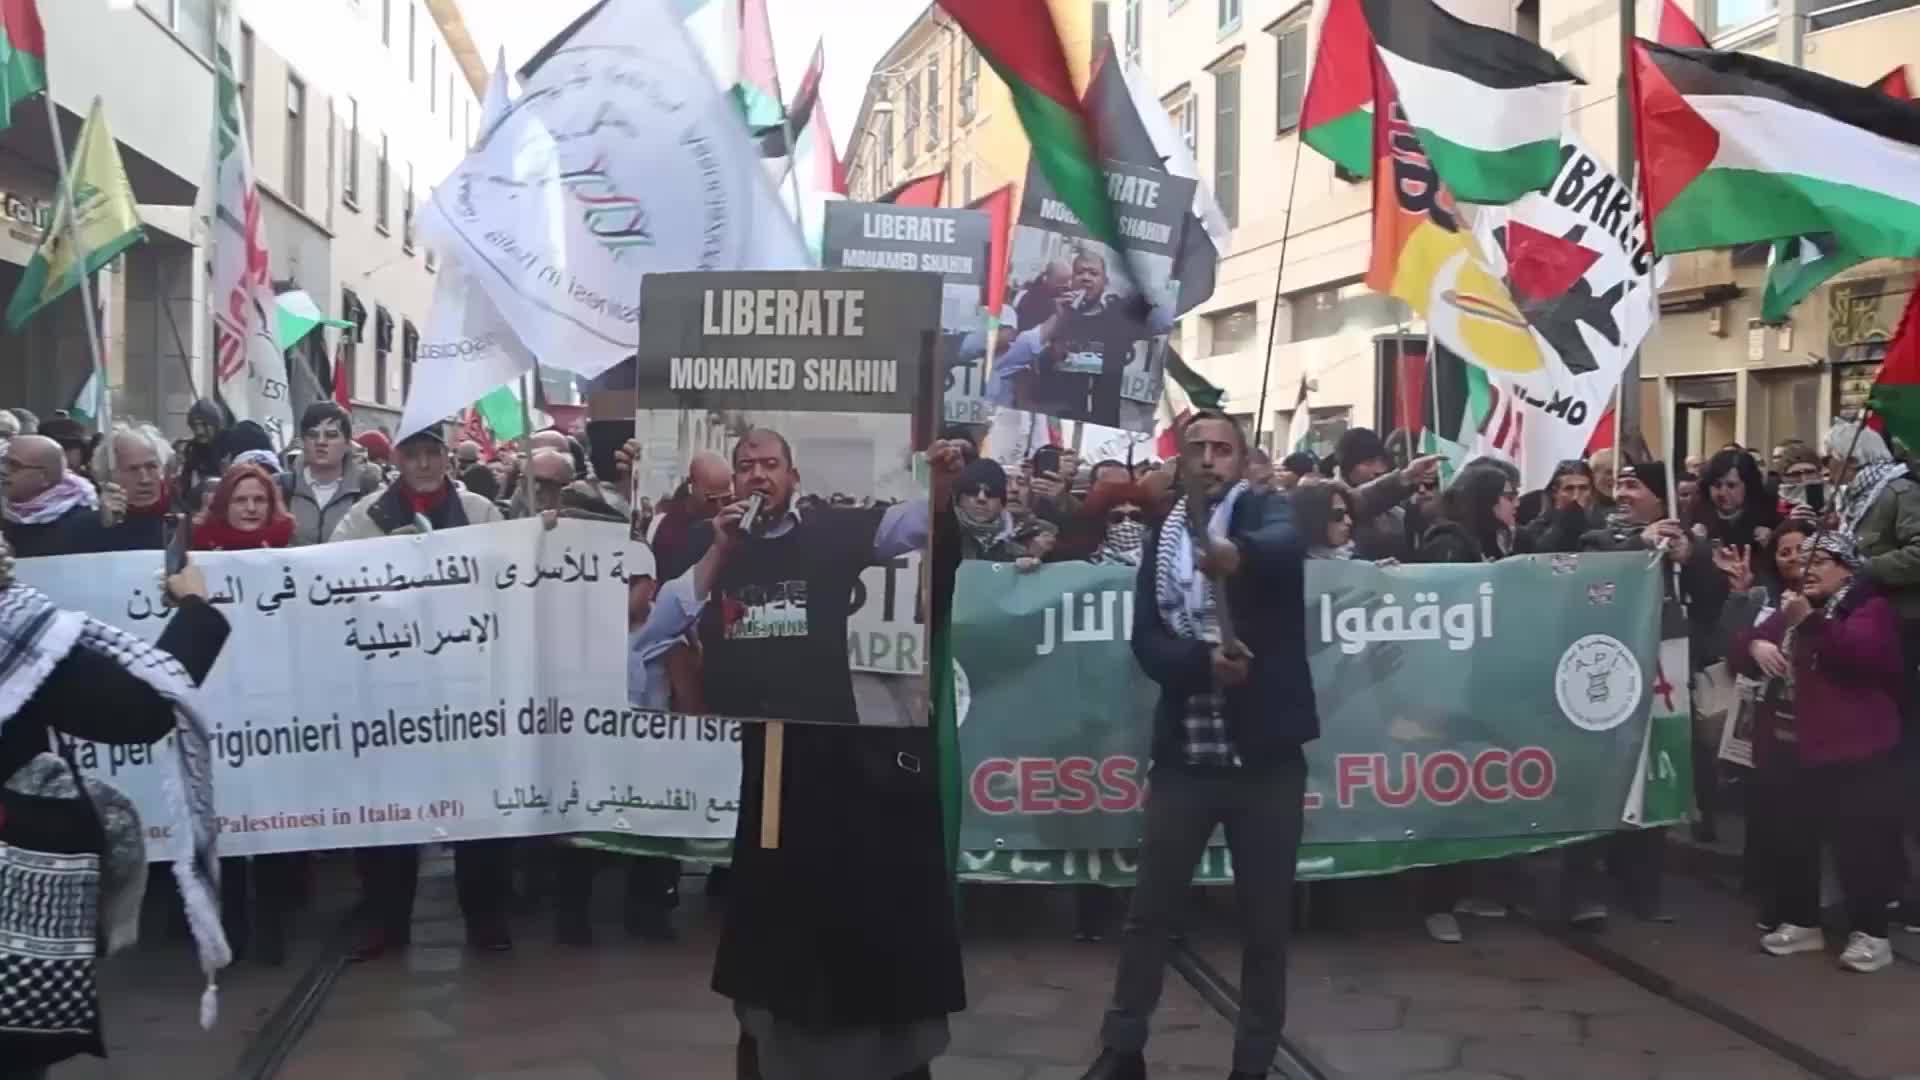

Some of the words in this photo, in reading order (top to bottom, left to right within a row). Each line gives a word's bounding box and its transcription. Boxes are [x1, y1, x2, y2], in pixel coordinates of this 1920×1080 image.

[1104, 171, 1161, 208] RATE
[863, 212, 957, 244] LIBERATE
[1118, 214, 1172, 245] SHAHIN
[842, 247, 917, 271] MOHAMED
[920, 253, 974, 274] SHAHIN
[703, 289, 865, 337] LIBERATE
[669, 357, 796, 391] MOHAMED
[803, 358, 898, 393] SHAHIN
[127, 575, 244, 621] السون
[256, 566, 298, 617] في
[308, 556, 480, 606] الفلسطينيين
[345, 613, 499, 661] الإسرائيلية
[1319, 582, 1494, 655] أوقفوا
[351, 698, 506, 759] palestinesi
[518, 697, 574, 736] dalle
[584, 706, 687, 740] carceri
[586, 784, 697, 817] الفلسطيني
[969, 756, 1147, 814] CESS
[1336, 747, 1556, 808] FUOCO
[214, 808, 325, 835] Palestinesi
[332, 806, 351, 825] in
[359, 801, 411, 824] Italia
[418, 799, 464, 822] (API)
